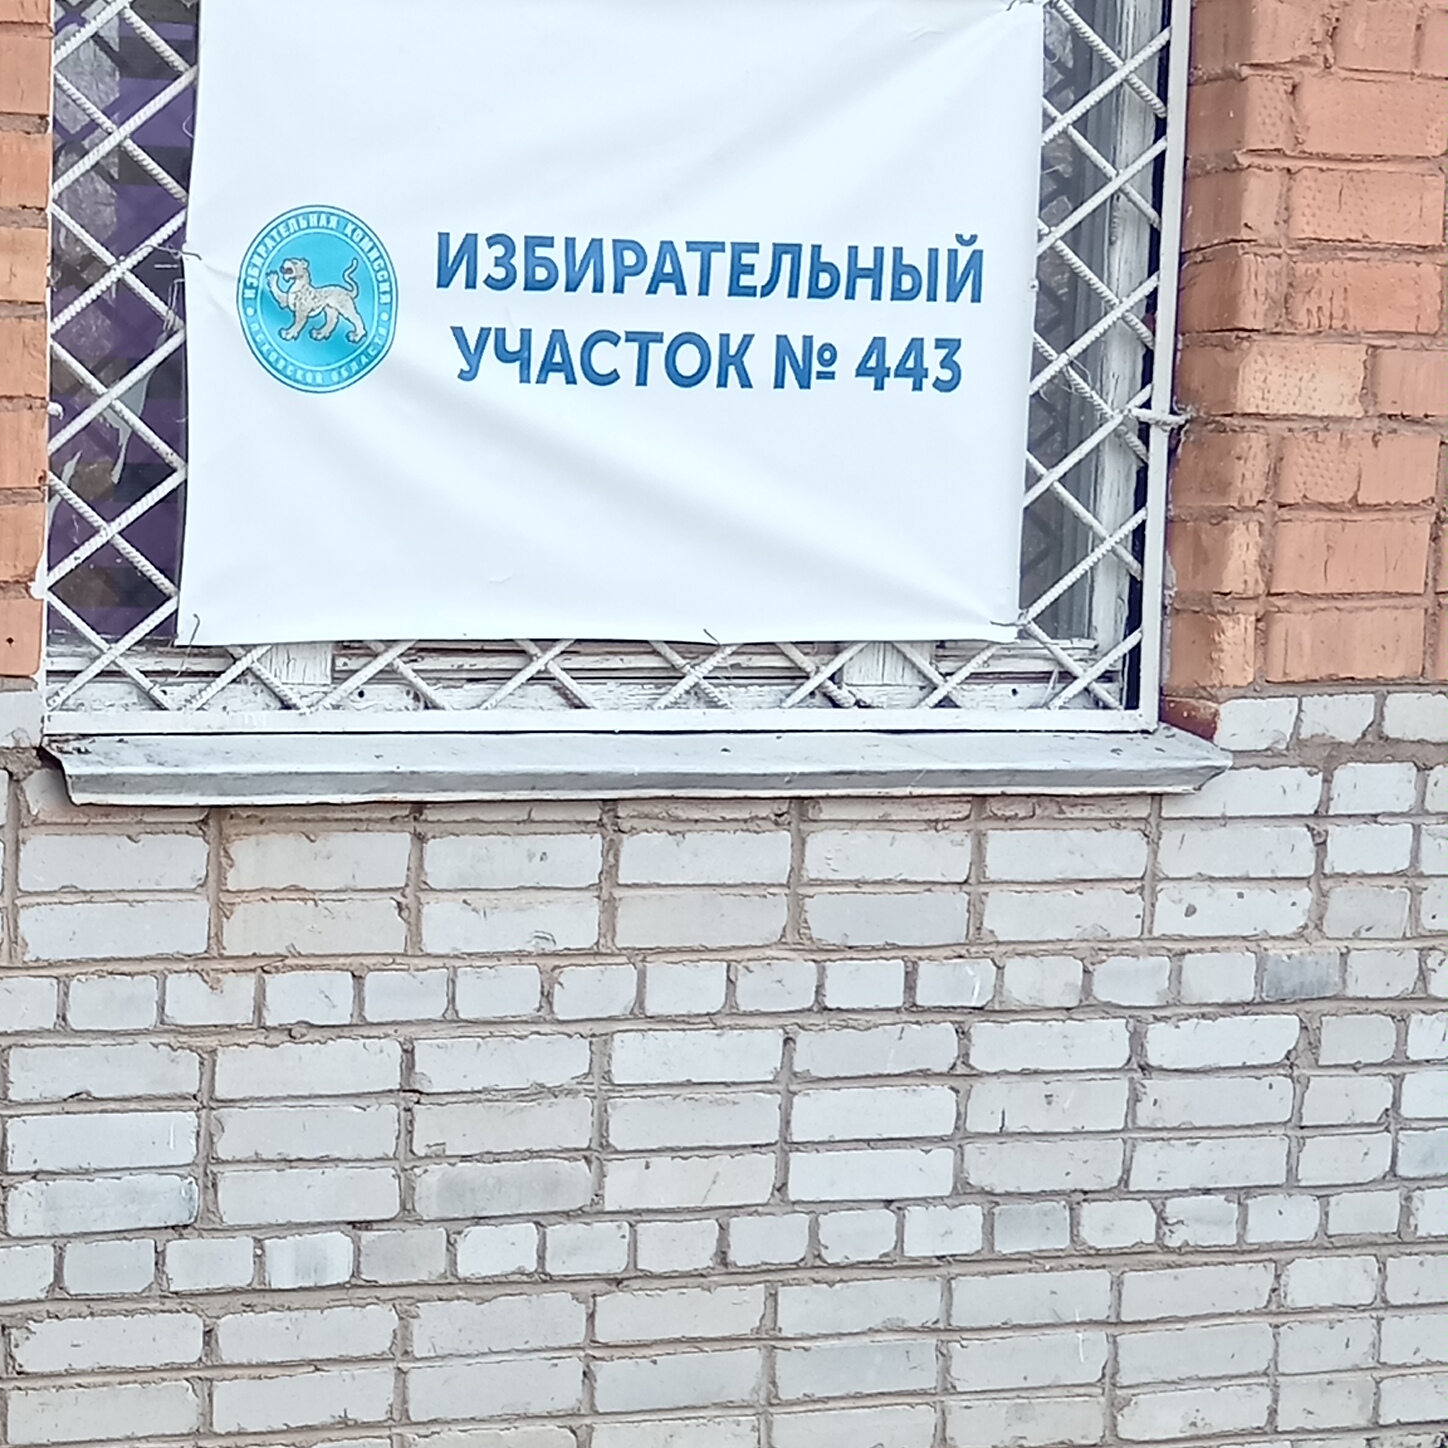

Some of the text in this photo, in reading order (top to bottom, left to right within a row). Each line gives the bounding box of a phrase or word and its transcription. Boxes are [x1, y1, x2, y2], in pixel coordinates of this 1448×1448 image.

[243, 213, 392, 304] ИЗБИРАТЕЛЬНАЯ КОМИССИЯ
[435, 232, 985, 305] ИЗБИРАТЕЛЬНЫЙ
[450, 326, 963, 393] УЧАСТОК № 443
